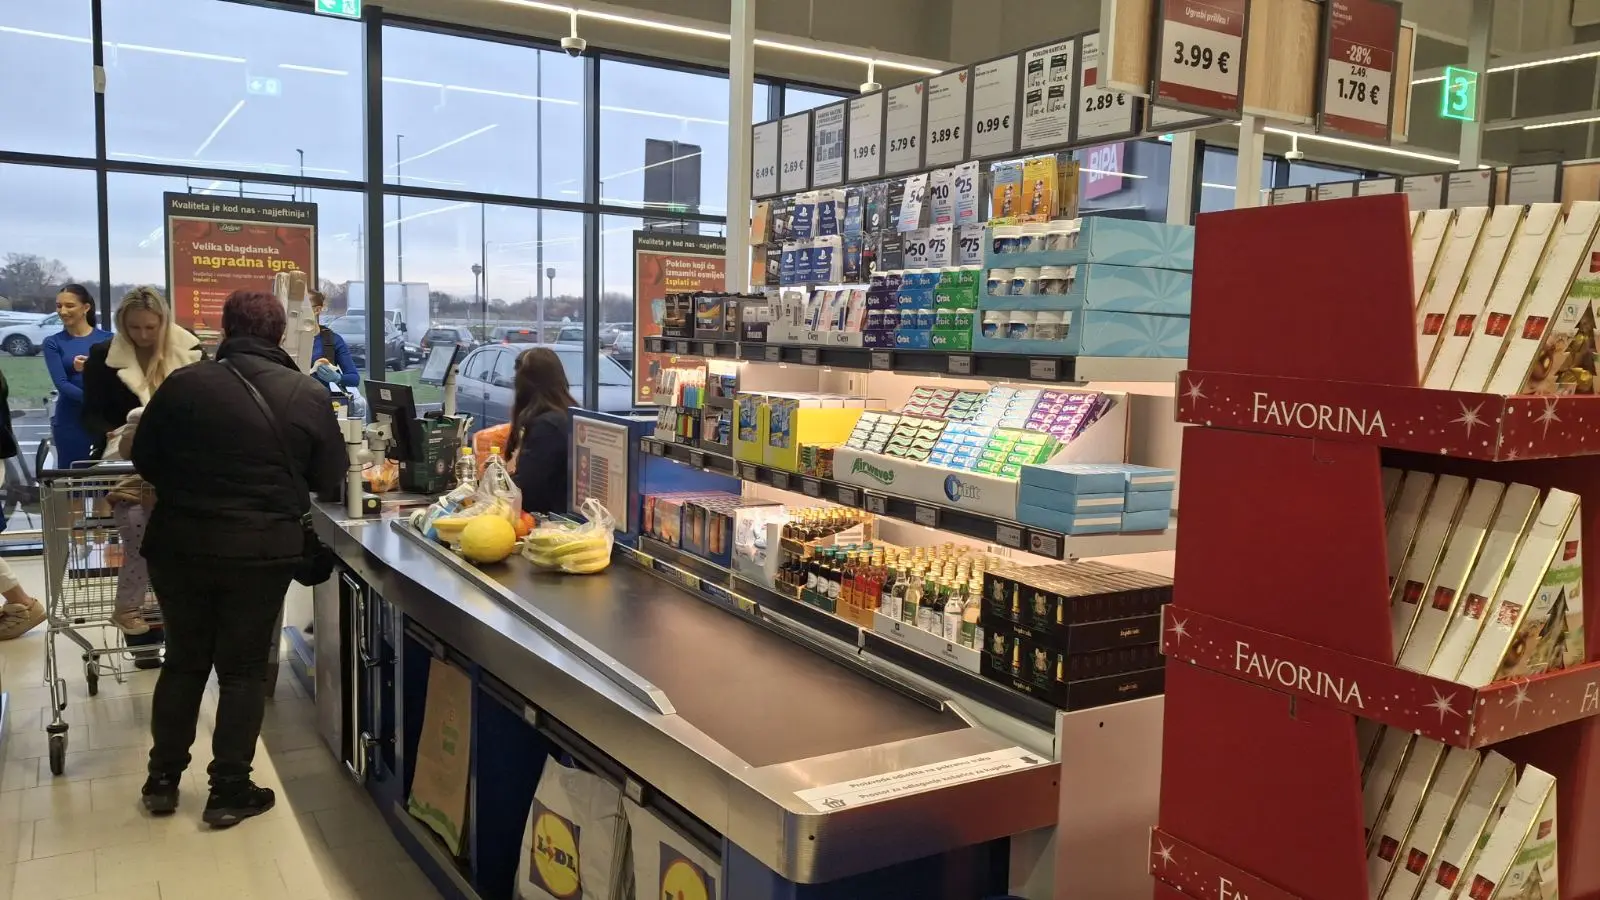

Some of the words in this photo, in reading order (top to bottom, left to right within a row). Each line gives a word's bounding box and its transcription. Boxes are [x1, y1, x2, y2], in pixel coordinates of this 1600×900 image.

[1185, 7, 1207, 19] Ugrabi
[1174, 41, 1213, 70] 3.99
[1217, 51, 1231, 73] €
[1346, 44, 1372, 65] -28%
[1338, 78, 1366, 102] 1.78
[1370, 85, 1380, 105] €
[1452, 76, 1469, 111] 3
[1085, 95, 1113, 112] 2.89
[1116, 93, 1125, 106] €
[976, 119, 999, 134] 0.99
[1002, 115, 1010, 129] €
[931, 128, 950, 144] 3.89
[953, 126, 960, 139] €
[890, 138, 908, 152] 5.79
[910, 136, 916, 148] €
[853, 146, 869, 159] 1.99
[870, 144, 877, 155] €
[784, 161, 798, 173] 2.69
[799, 160, 804, 170] €
[1089, 144, 1117, 184] BIPA
[756, 168, 769, 179] 6.49
[770, 166, 774, 176] €
[936, 184, 949, 199] 10
[960, 178, 972, 194] 25
[172, 200, 210, 212] Kvaliteta
[212, 204, 220, 213] je
[222, 204, 238, 213] kod
[241, 206, 256, 214] nas
[262, 207, 305, 220] najjeftinija
[192, 242, 222, 252] Velika
[224, 244, 280, 255] blagdanska
[638, 237, 664, 246] Kvaliteta
[666, 240, 672, 248] je
[910, 243, 926, 256] 50
[934, 238, 946, 252] 75
[966, 238, 980, 252] 75
[192, 254, 264, 269] nagradna
[267, 256, 300, 272] igra.
[666, 260, 692, 268] Poklon
[692, 260, 706, 271] koji
[666, 269, 697, 278] izmamiti
[664, 278, 689, 286] Isplati
[868, 296, 880, 304] Orbit
[898, 296, 912, 304] Orbit
[936, 294, 951, 303] Orbit
[807, 333, 819, 342] Cien
[836, 334, 849, 343] Cien
[864, 334, 877, 342] Orbit
[896, 335, 910, 344] Orbit
[932, 336, 947, 344] Orbit
[1252, 392, 1388, 438] FAVORINA
[851, 458, 894, 484] Airwaves
[944, 473, 982, 502] Orbit
[1235, 640, 1364, 709] FAVORINA
[536, 834, 578, 873] LIDL
